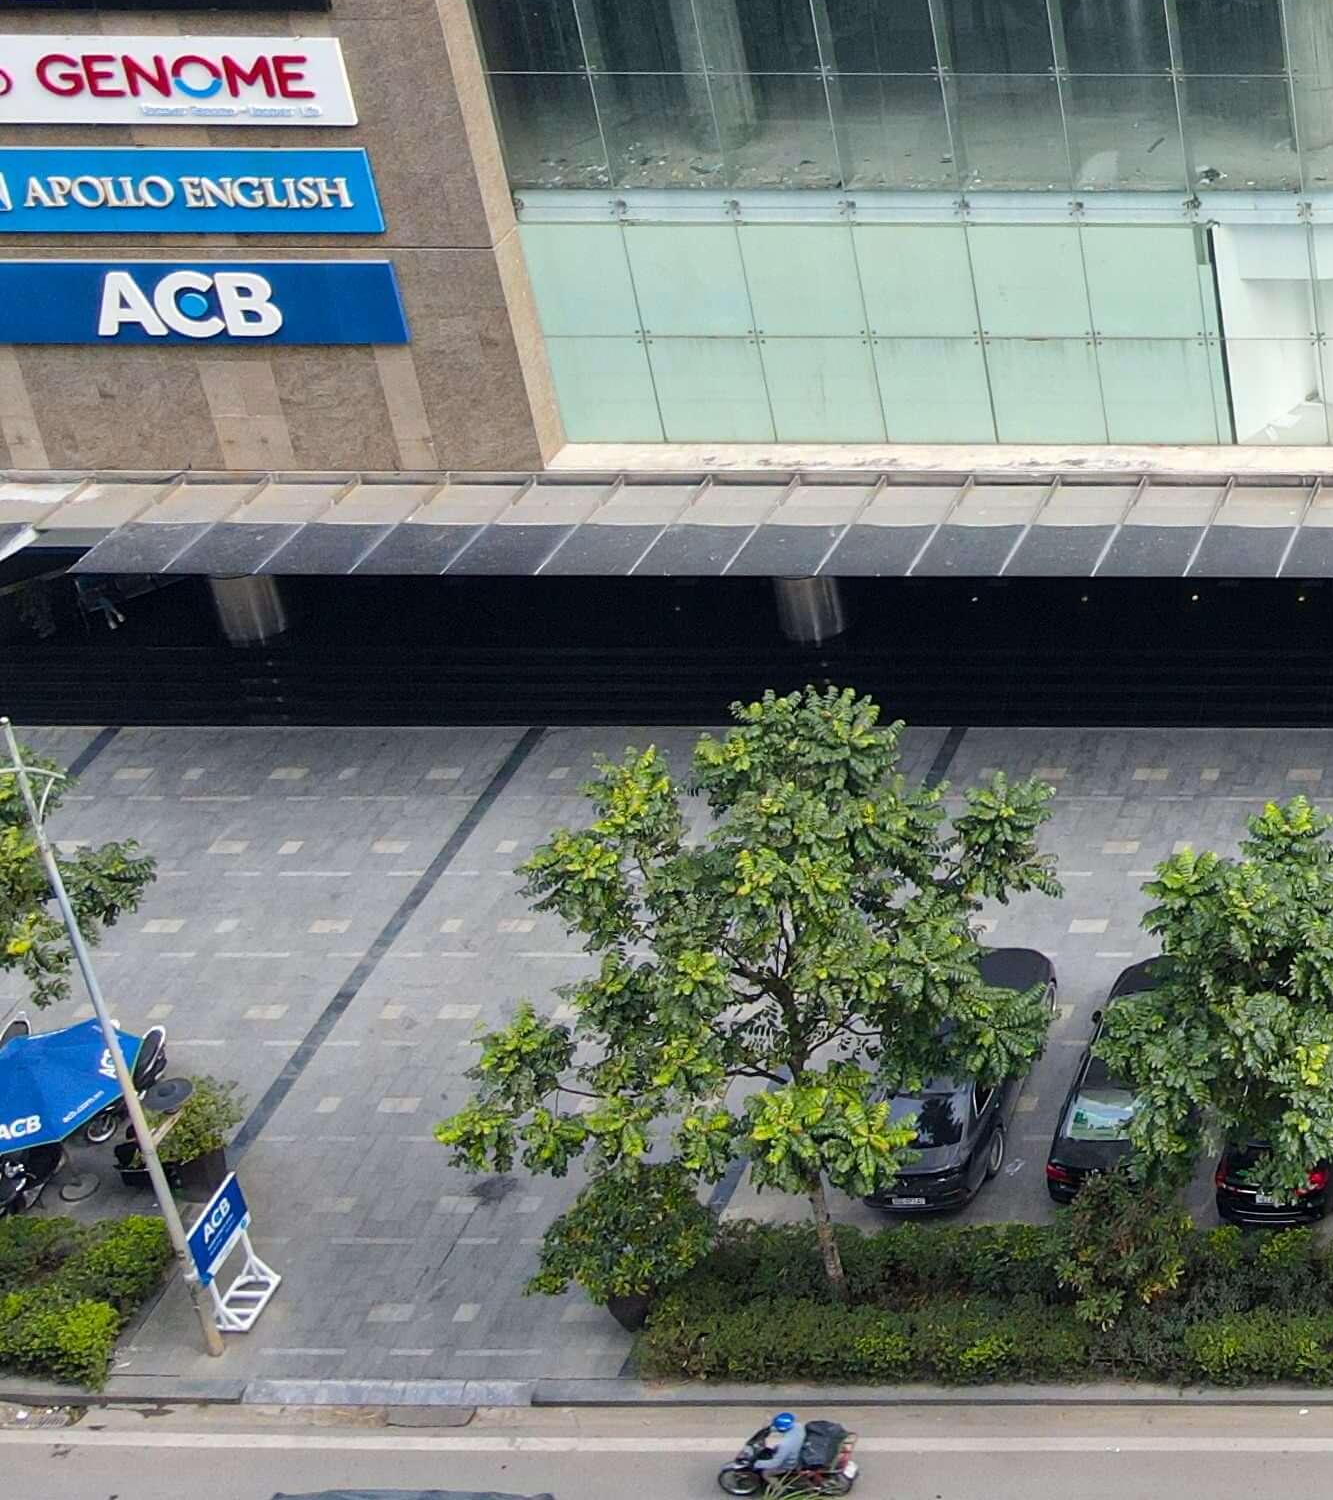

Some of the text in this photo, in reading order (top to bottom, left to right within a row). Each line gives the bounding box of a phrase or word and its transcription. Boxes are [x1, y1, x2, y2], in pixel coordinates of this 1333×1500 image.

[36, 54, 315, 99] GENOME
[24, 175, 354, 209] APOLLO ENGLISH
[98, 270, 283, 338] ACB
[204, 1197, 230, 1244] ACB
